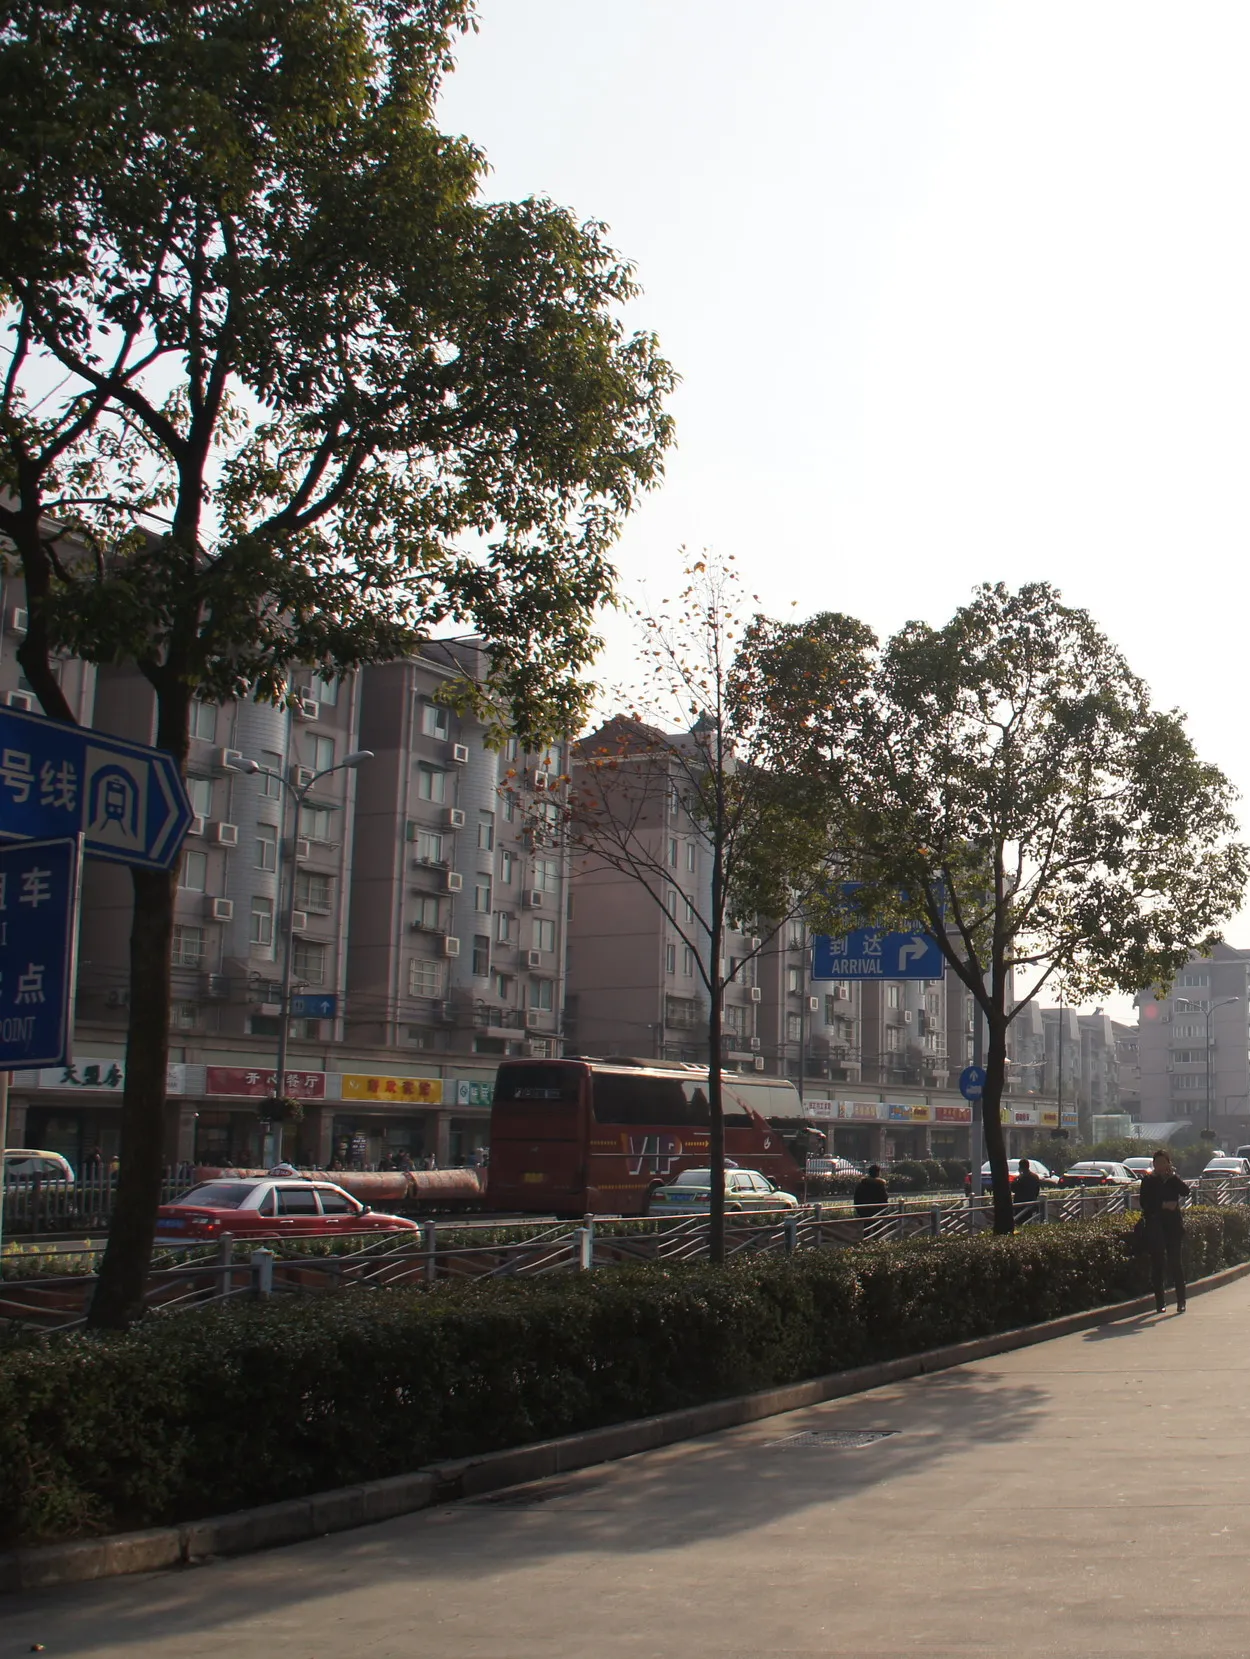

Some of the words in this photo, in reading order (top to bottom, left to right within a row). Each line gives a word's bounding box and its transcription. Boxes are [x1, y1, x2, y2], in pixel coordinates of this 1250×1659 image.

[829, 934, 882, 957] 到达
[831, 958, 883, 975] ARRIVAL
[621, 1133, 683, 1176] VIP
